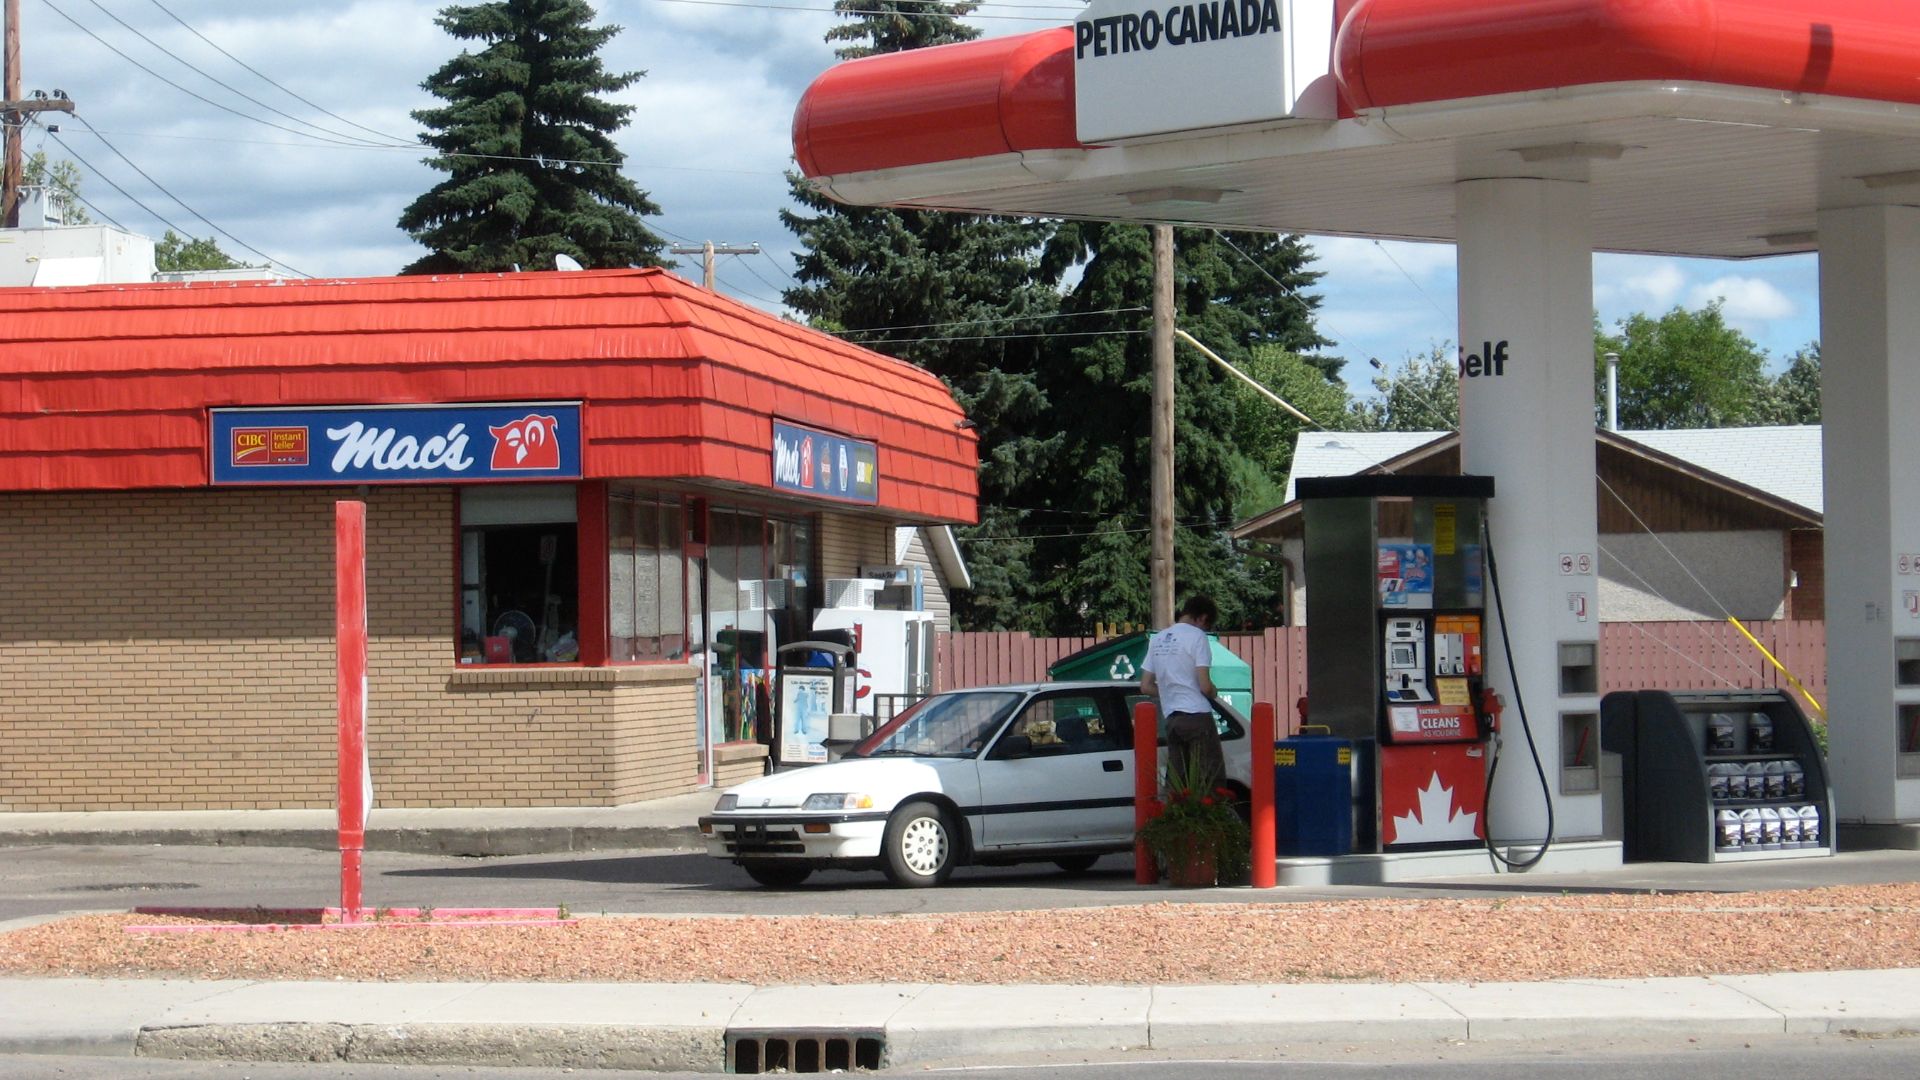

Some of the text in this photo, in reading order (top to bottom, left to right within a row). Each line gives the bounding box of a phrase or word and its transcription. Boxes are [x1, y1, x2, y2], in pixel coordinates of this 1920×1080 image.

[1076, 0, 1281, 59] PETRO-CANADA
[237, 434, 266, 446] CIBC
[273, 433, 302, 441] Instant
[274, 441, 295, 450] teller
[326, 421, 475, 473] Mac's
[1415, 620, 1423, 632] 4
[1421, 717, 1460, 730] CLEANS
